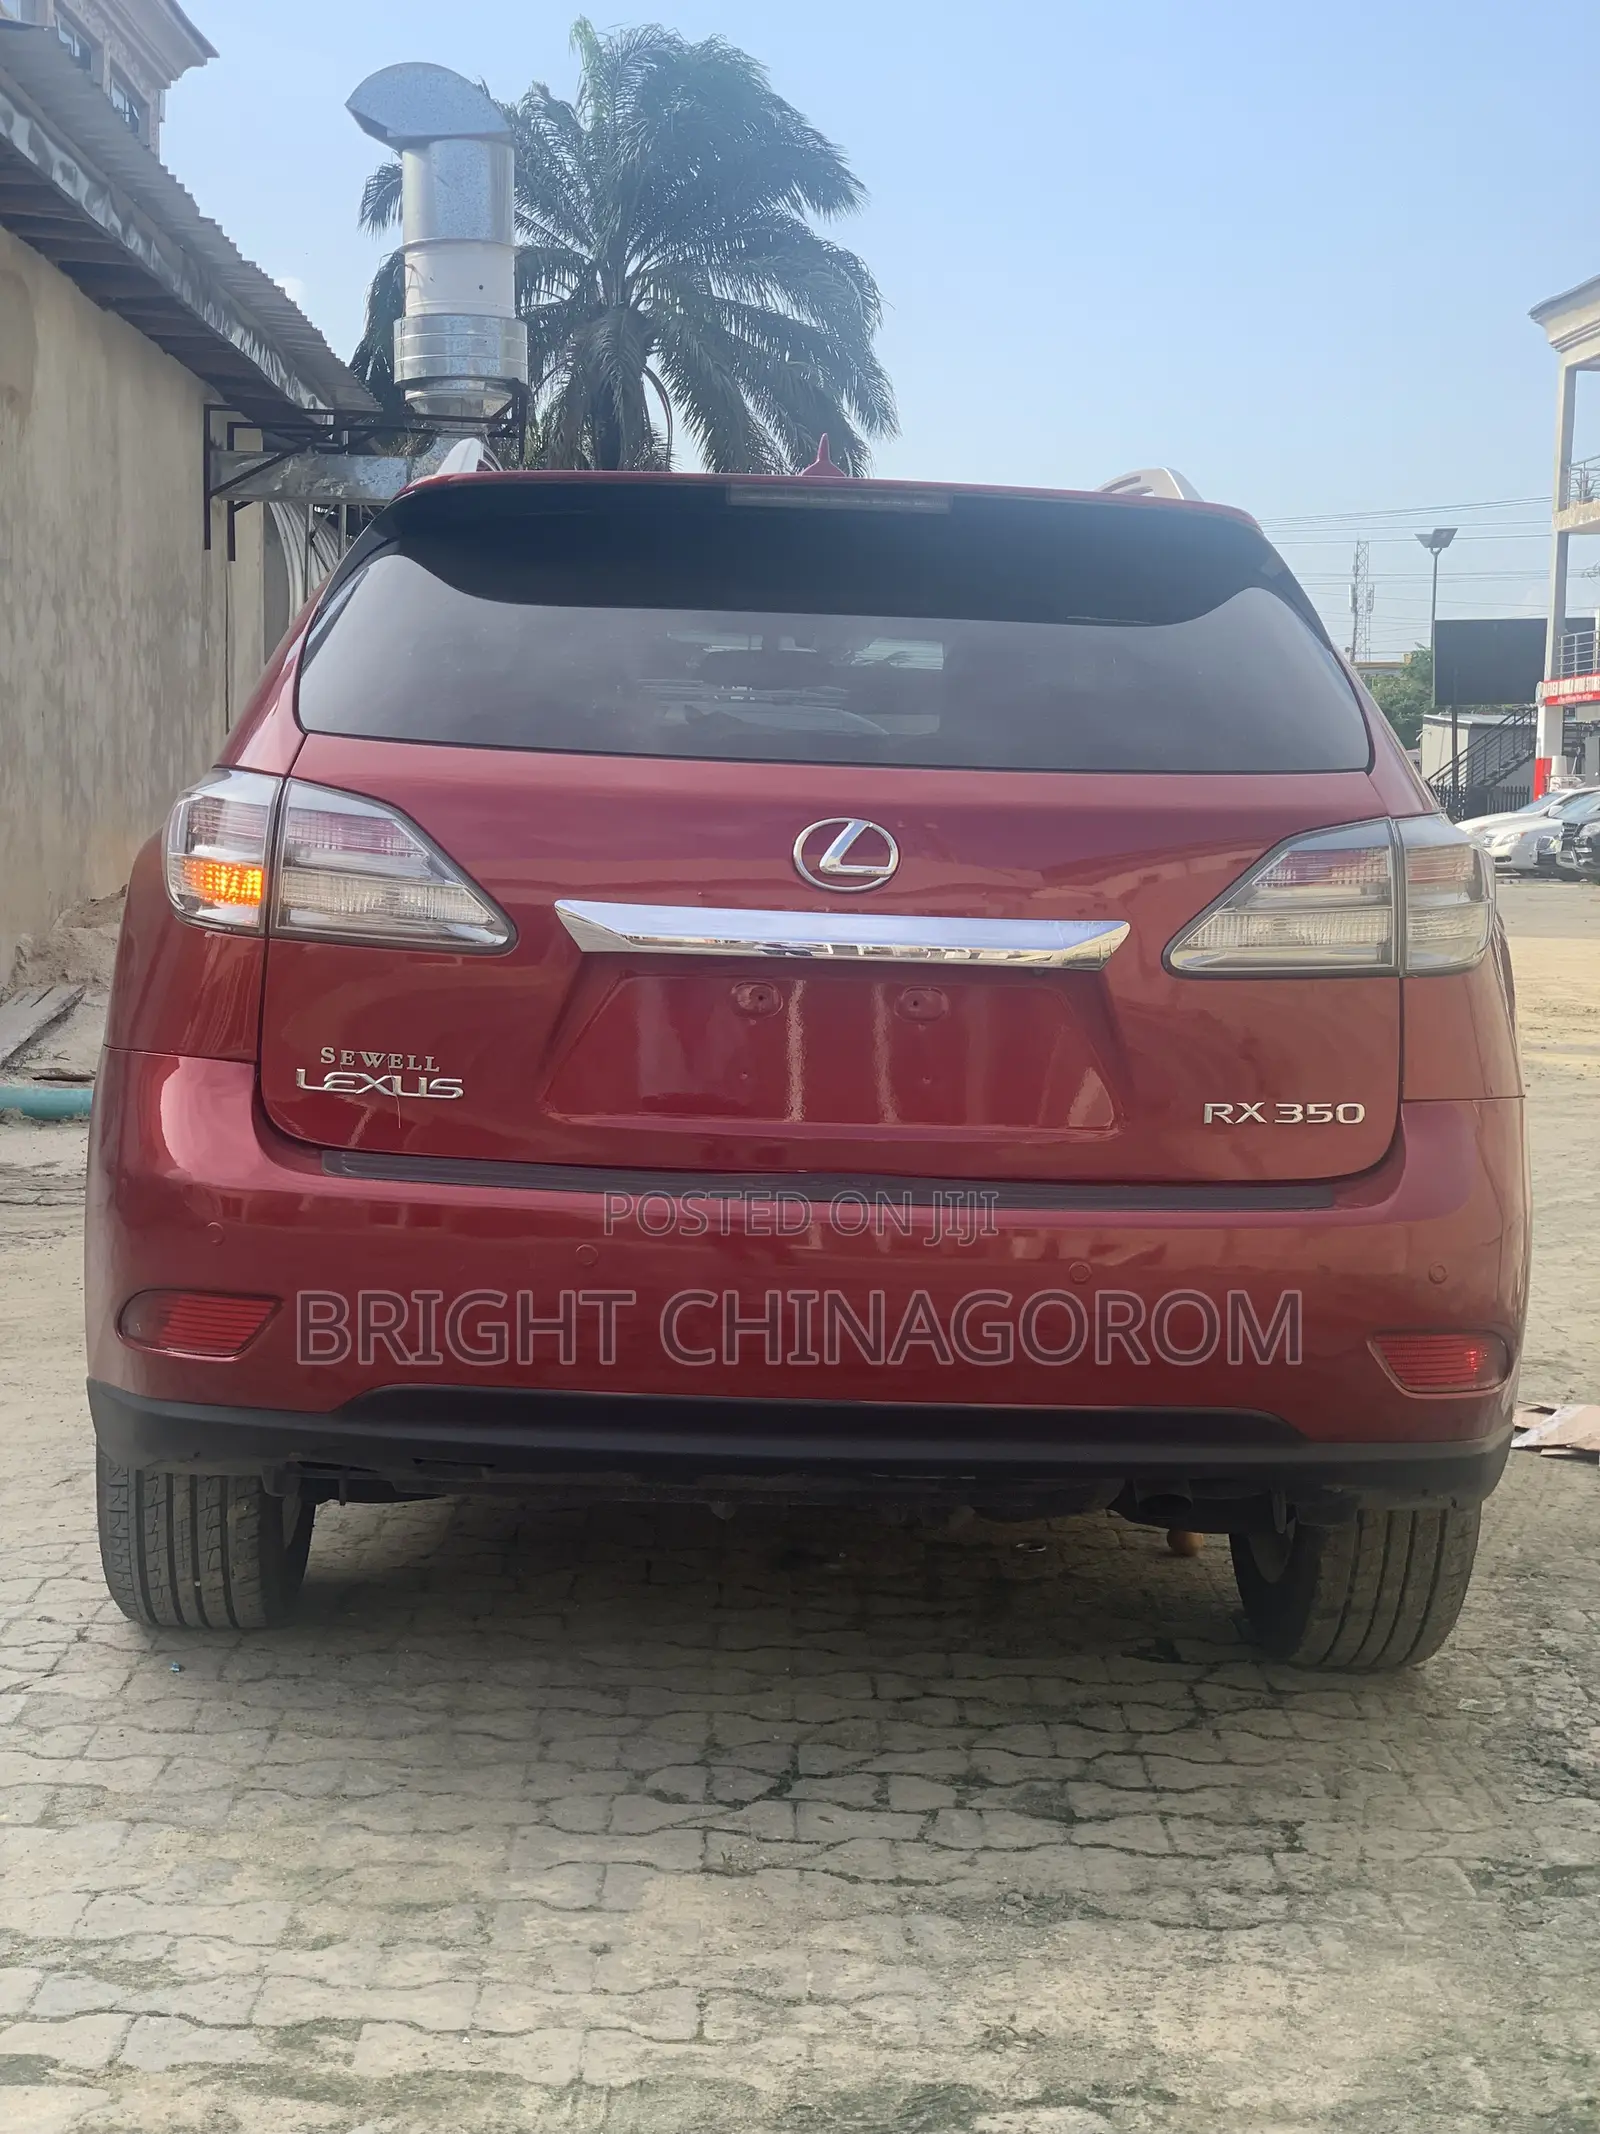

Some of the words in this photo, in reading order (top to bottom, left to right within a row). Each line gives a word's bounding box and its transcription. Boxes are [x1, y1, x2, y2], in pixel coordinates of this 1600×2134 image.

[320, 1046, 440, 1073] SEWELL
[296, 1068, 464, 1099] LEXUS
[1203, 1102, 1268, 1125] RX
[1274, 1102, 1366, 1125] 350
